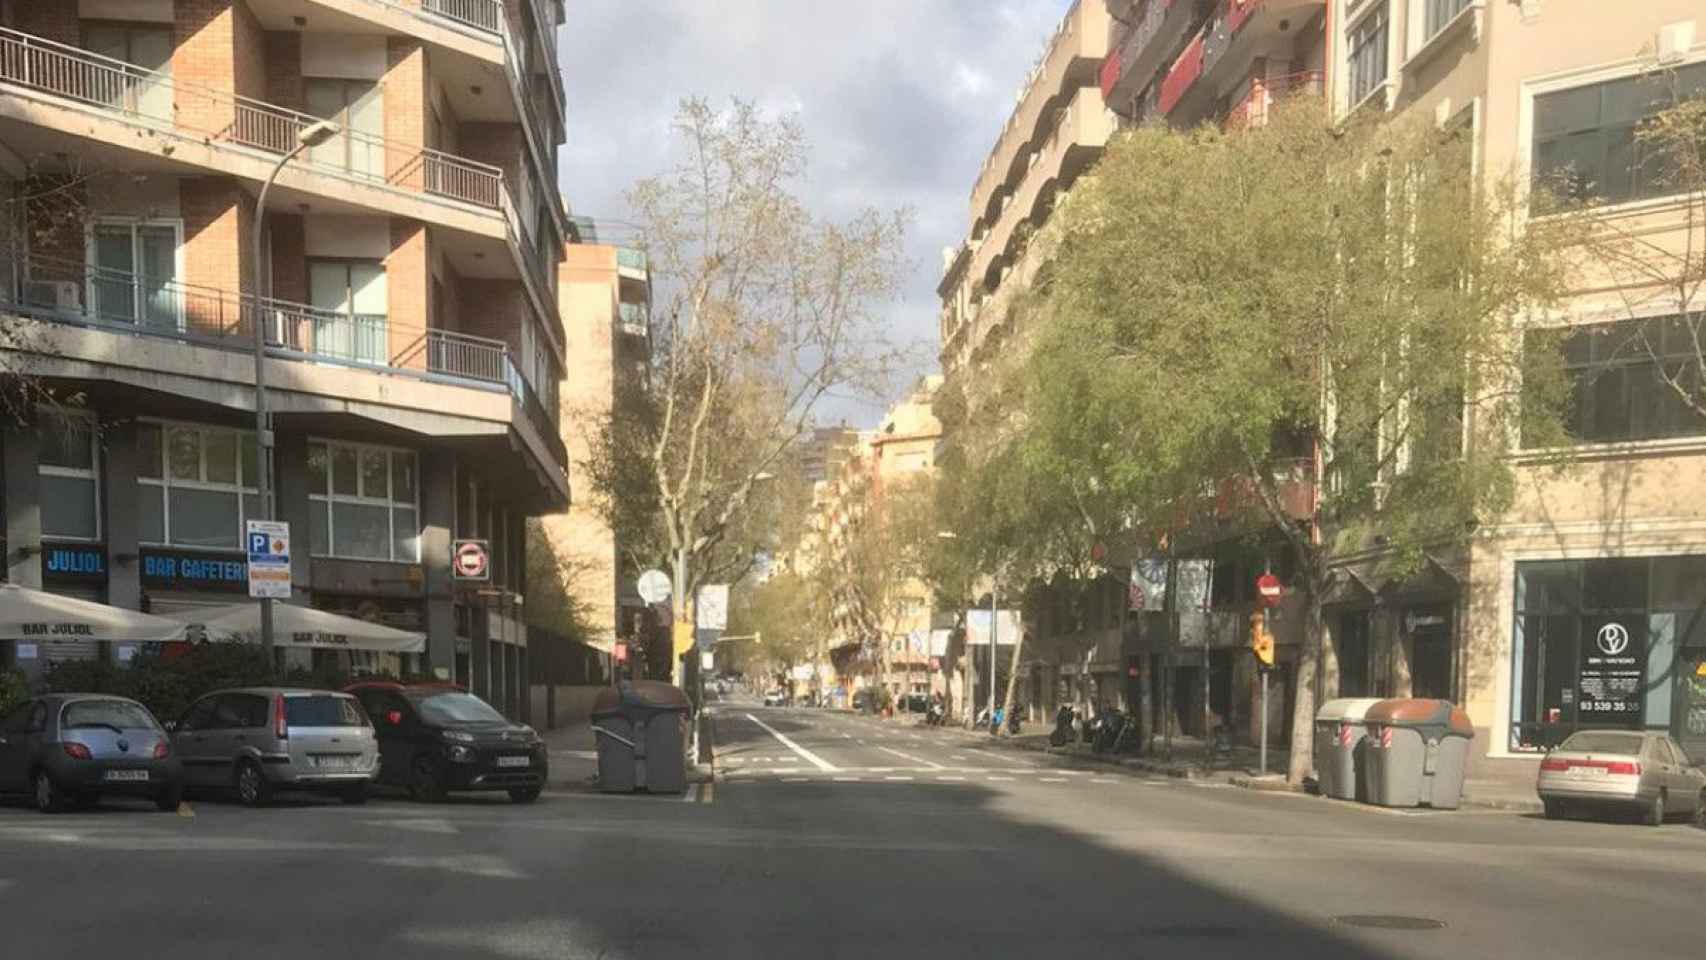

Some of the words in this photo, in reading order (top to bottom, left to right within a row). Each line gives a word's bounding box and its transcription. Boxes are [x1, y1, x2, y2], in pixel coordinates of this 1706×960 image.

[253, 534, 266, 553] P
[47, 551, 105, 573] JULIOL
[144, 555, 177, 577] BAR
[181, 558, 248, 581] CAFETERI
[22, 623, 48, 636] BAR
[51, 623, 94, 636] JULIOL
[293, 631, 313, 643] BAR
[315, 631, 349, 645] JULIOL
